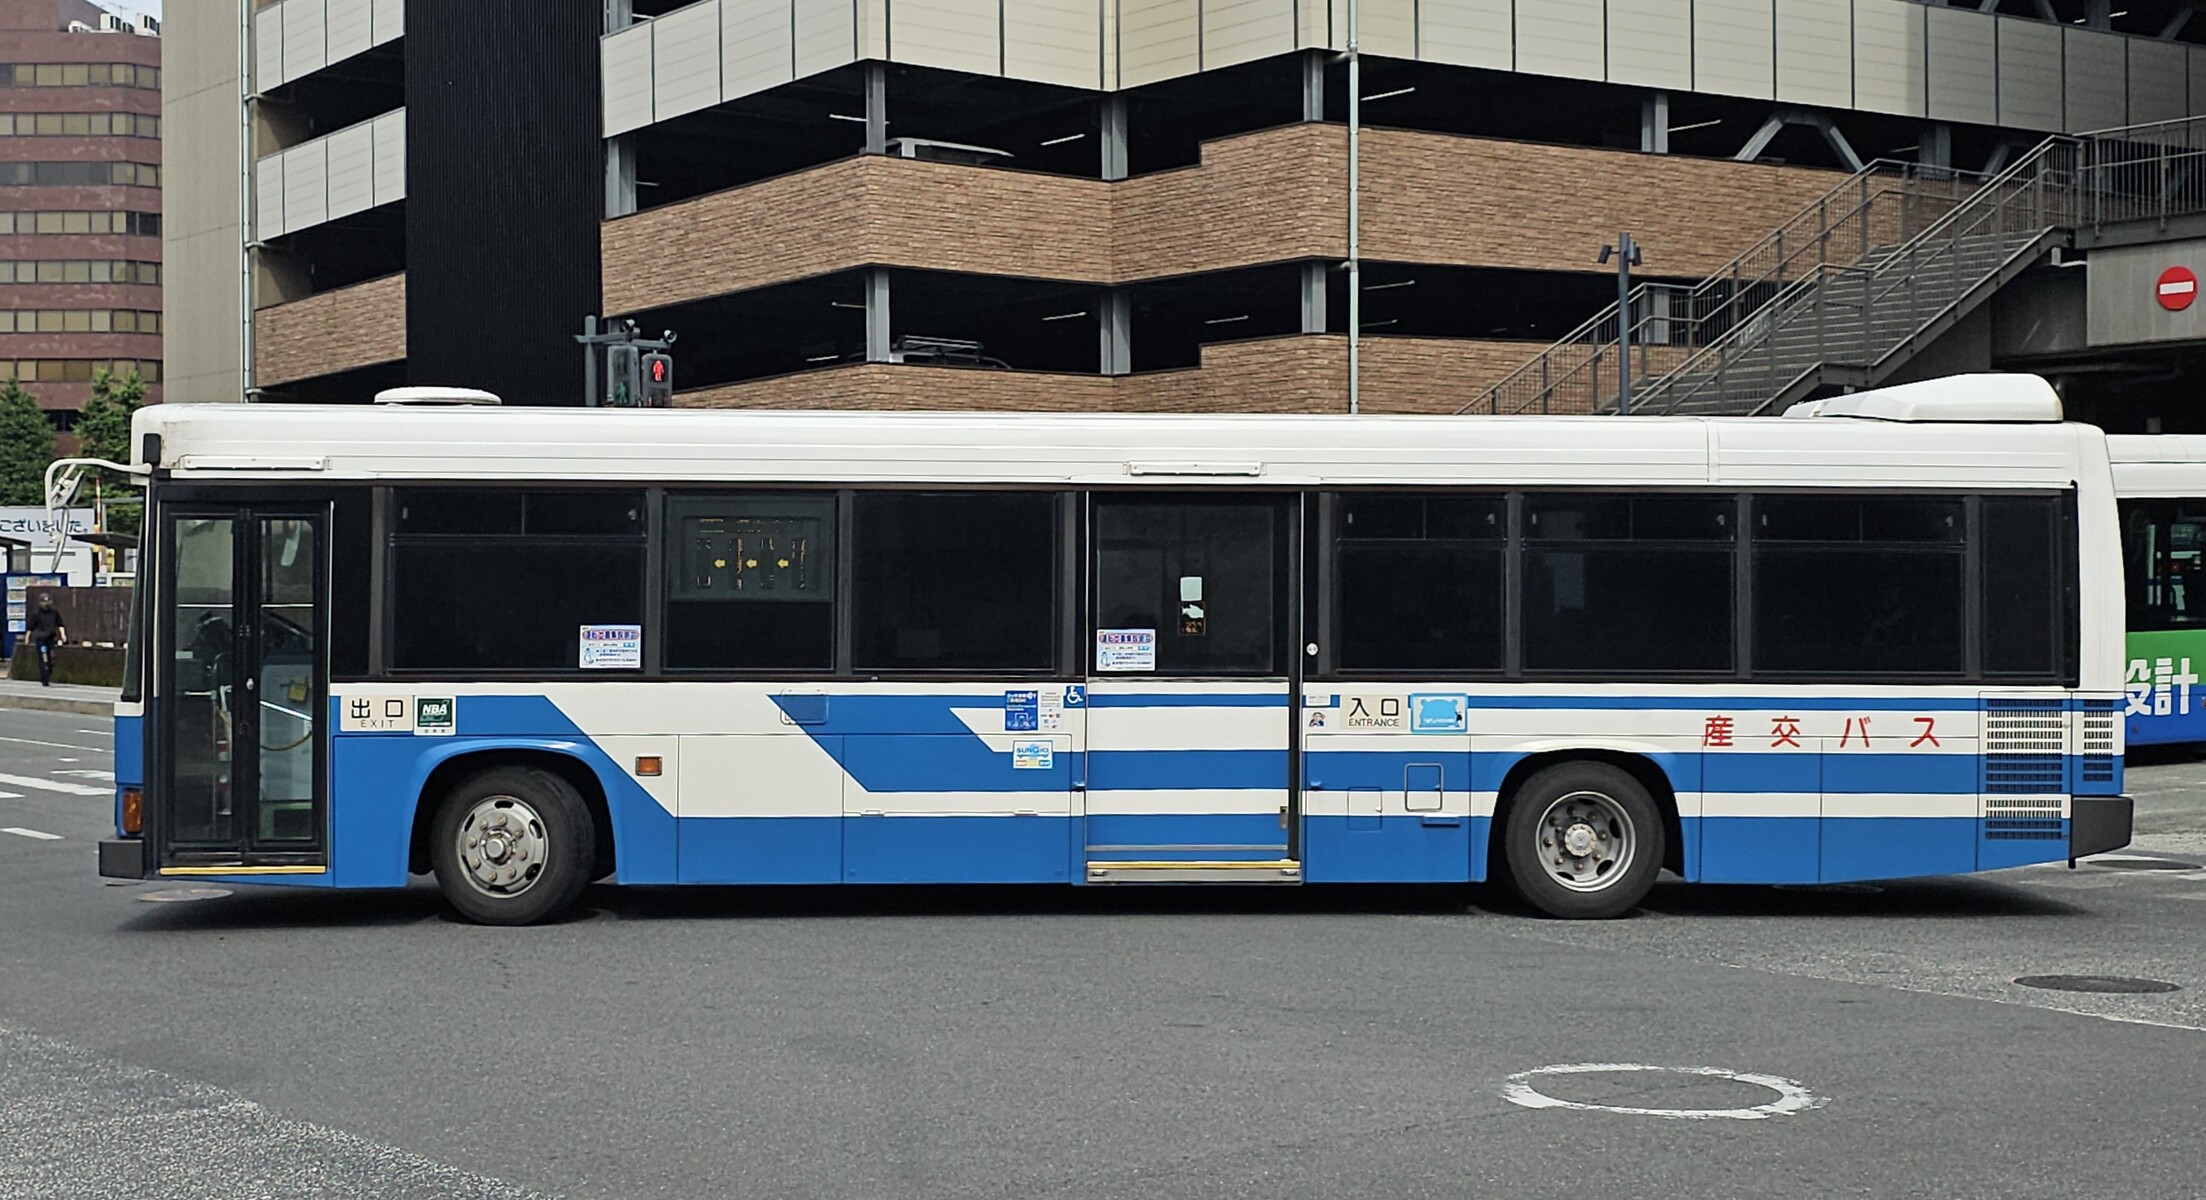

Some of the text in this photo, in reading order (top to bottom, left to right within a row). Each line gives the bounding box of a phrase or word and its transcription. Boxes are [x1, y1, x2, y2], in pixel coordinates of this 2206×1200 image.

[351, 698, 403, 719] 出口
[422, 704, 448, 716] NBA
[1349, 698, 1399, 717] 入口
[360, 720, 395, 728] EXIT
[1349, 718, 1400, 727] ENTRANCE
[1703, 715, 1940, 748] 産交バス
